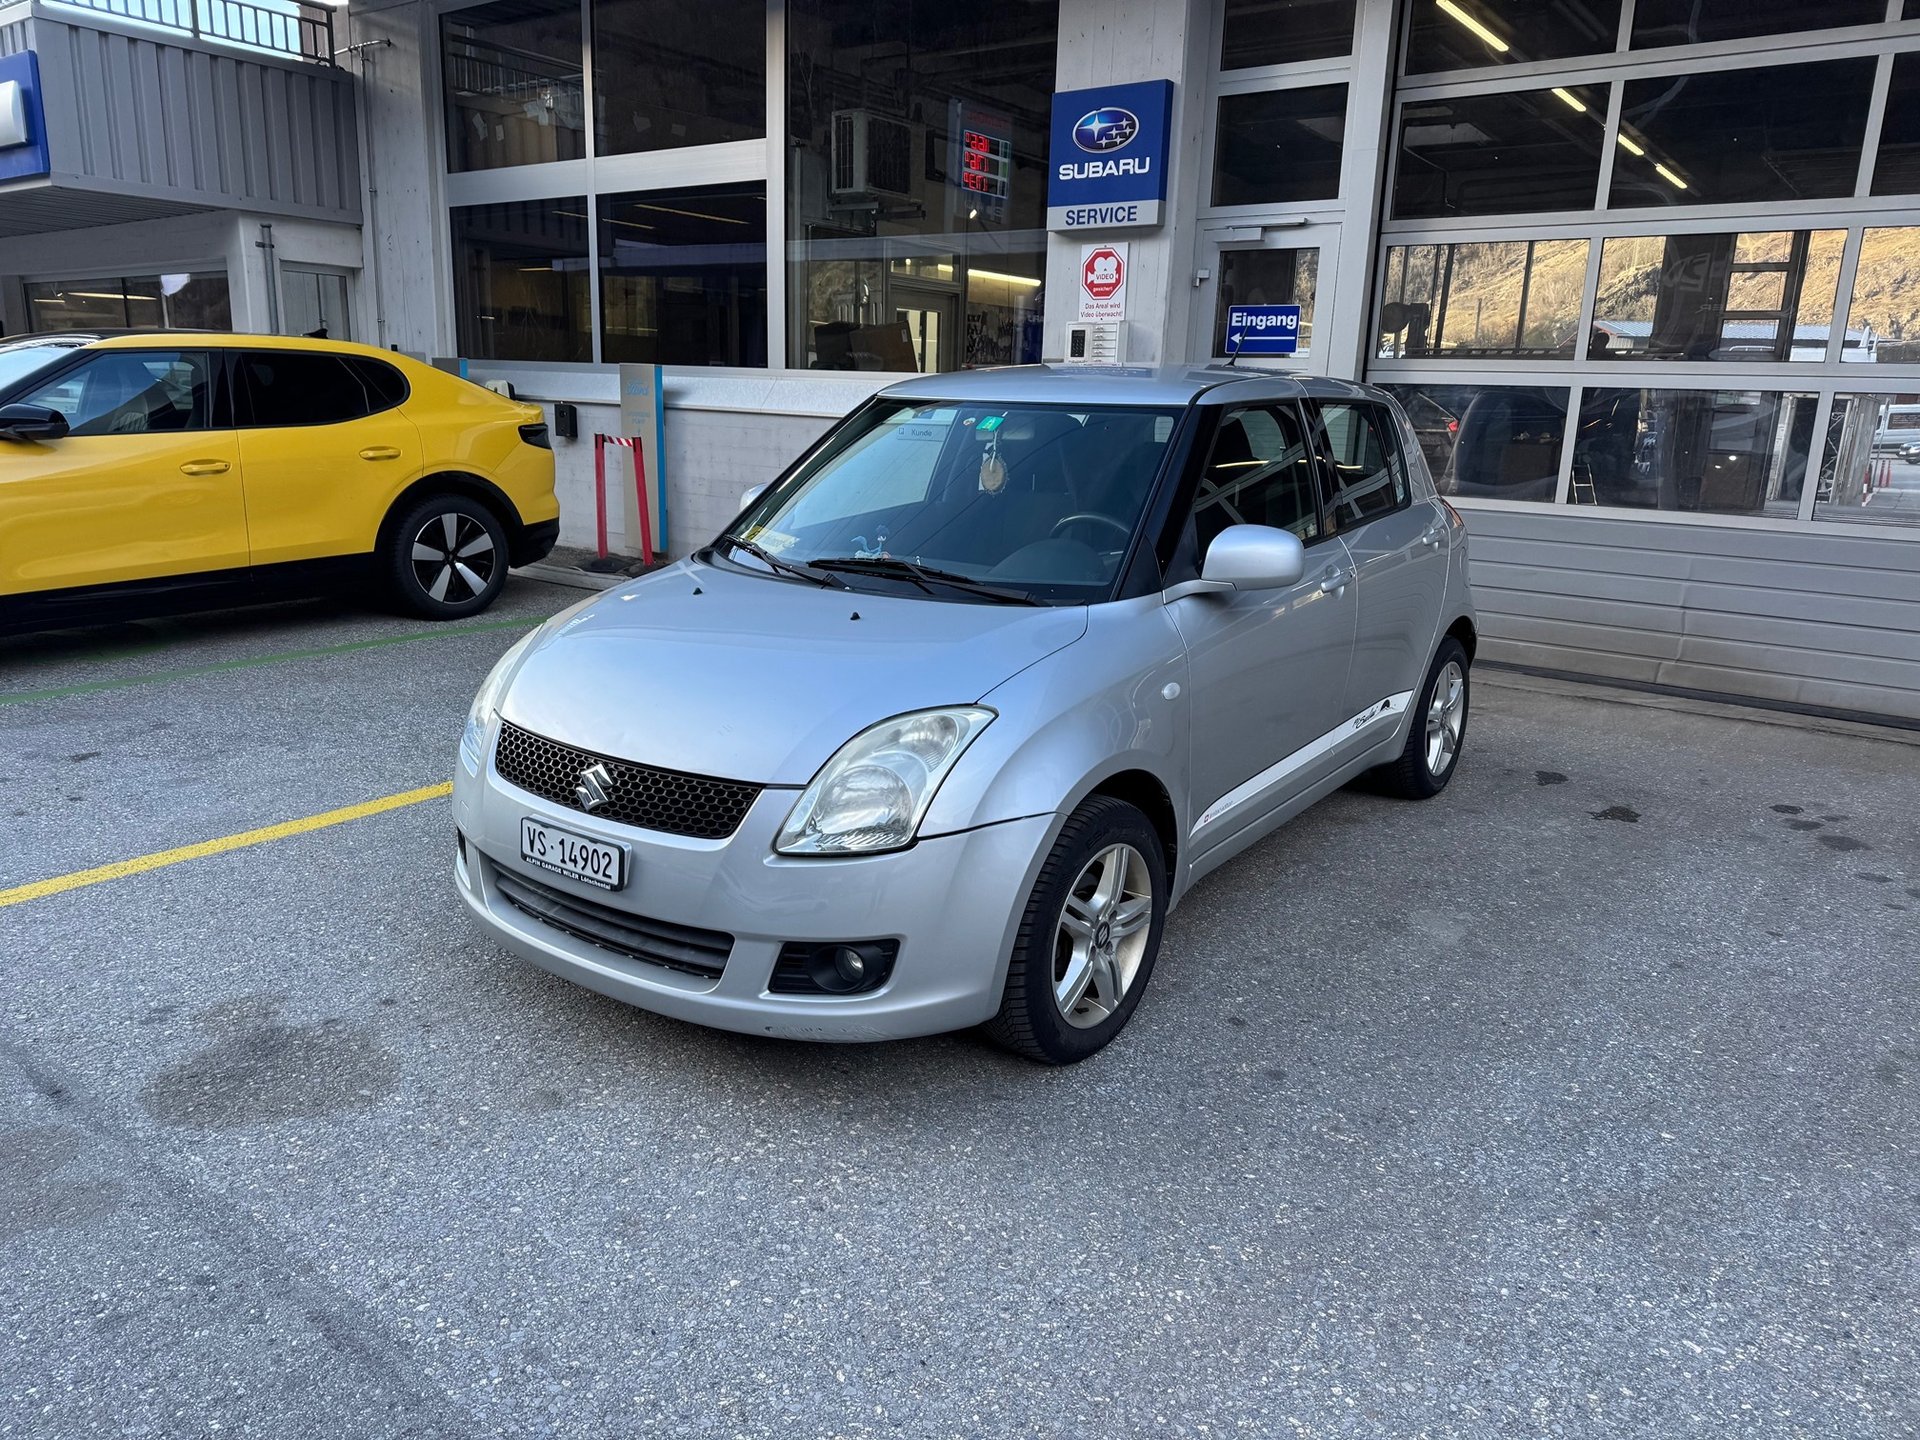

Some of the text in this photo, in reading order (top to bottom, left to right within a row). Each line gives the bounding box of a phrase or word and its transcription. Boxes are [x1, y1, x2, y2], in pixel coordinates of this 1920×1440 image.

[1058, 156, 1151, 180] SUBARU
[1065, 205, 1138, 226] SERVICE
[1231, 312, 1298, 330] Eingang
[911, 428, 933, 437] Kunde
[526, 856, 541, 866] ALPIN
[541, 862, 562, 874] GARAGE
[563, 869, 580, 880] WILER
